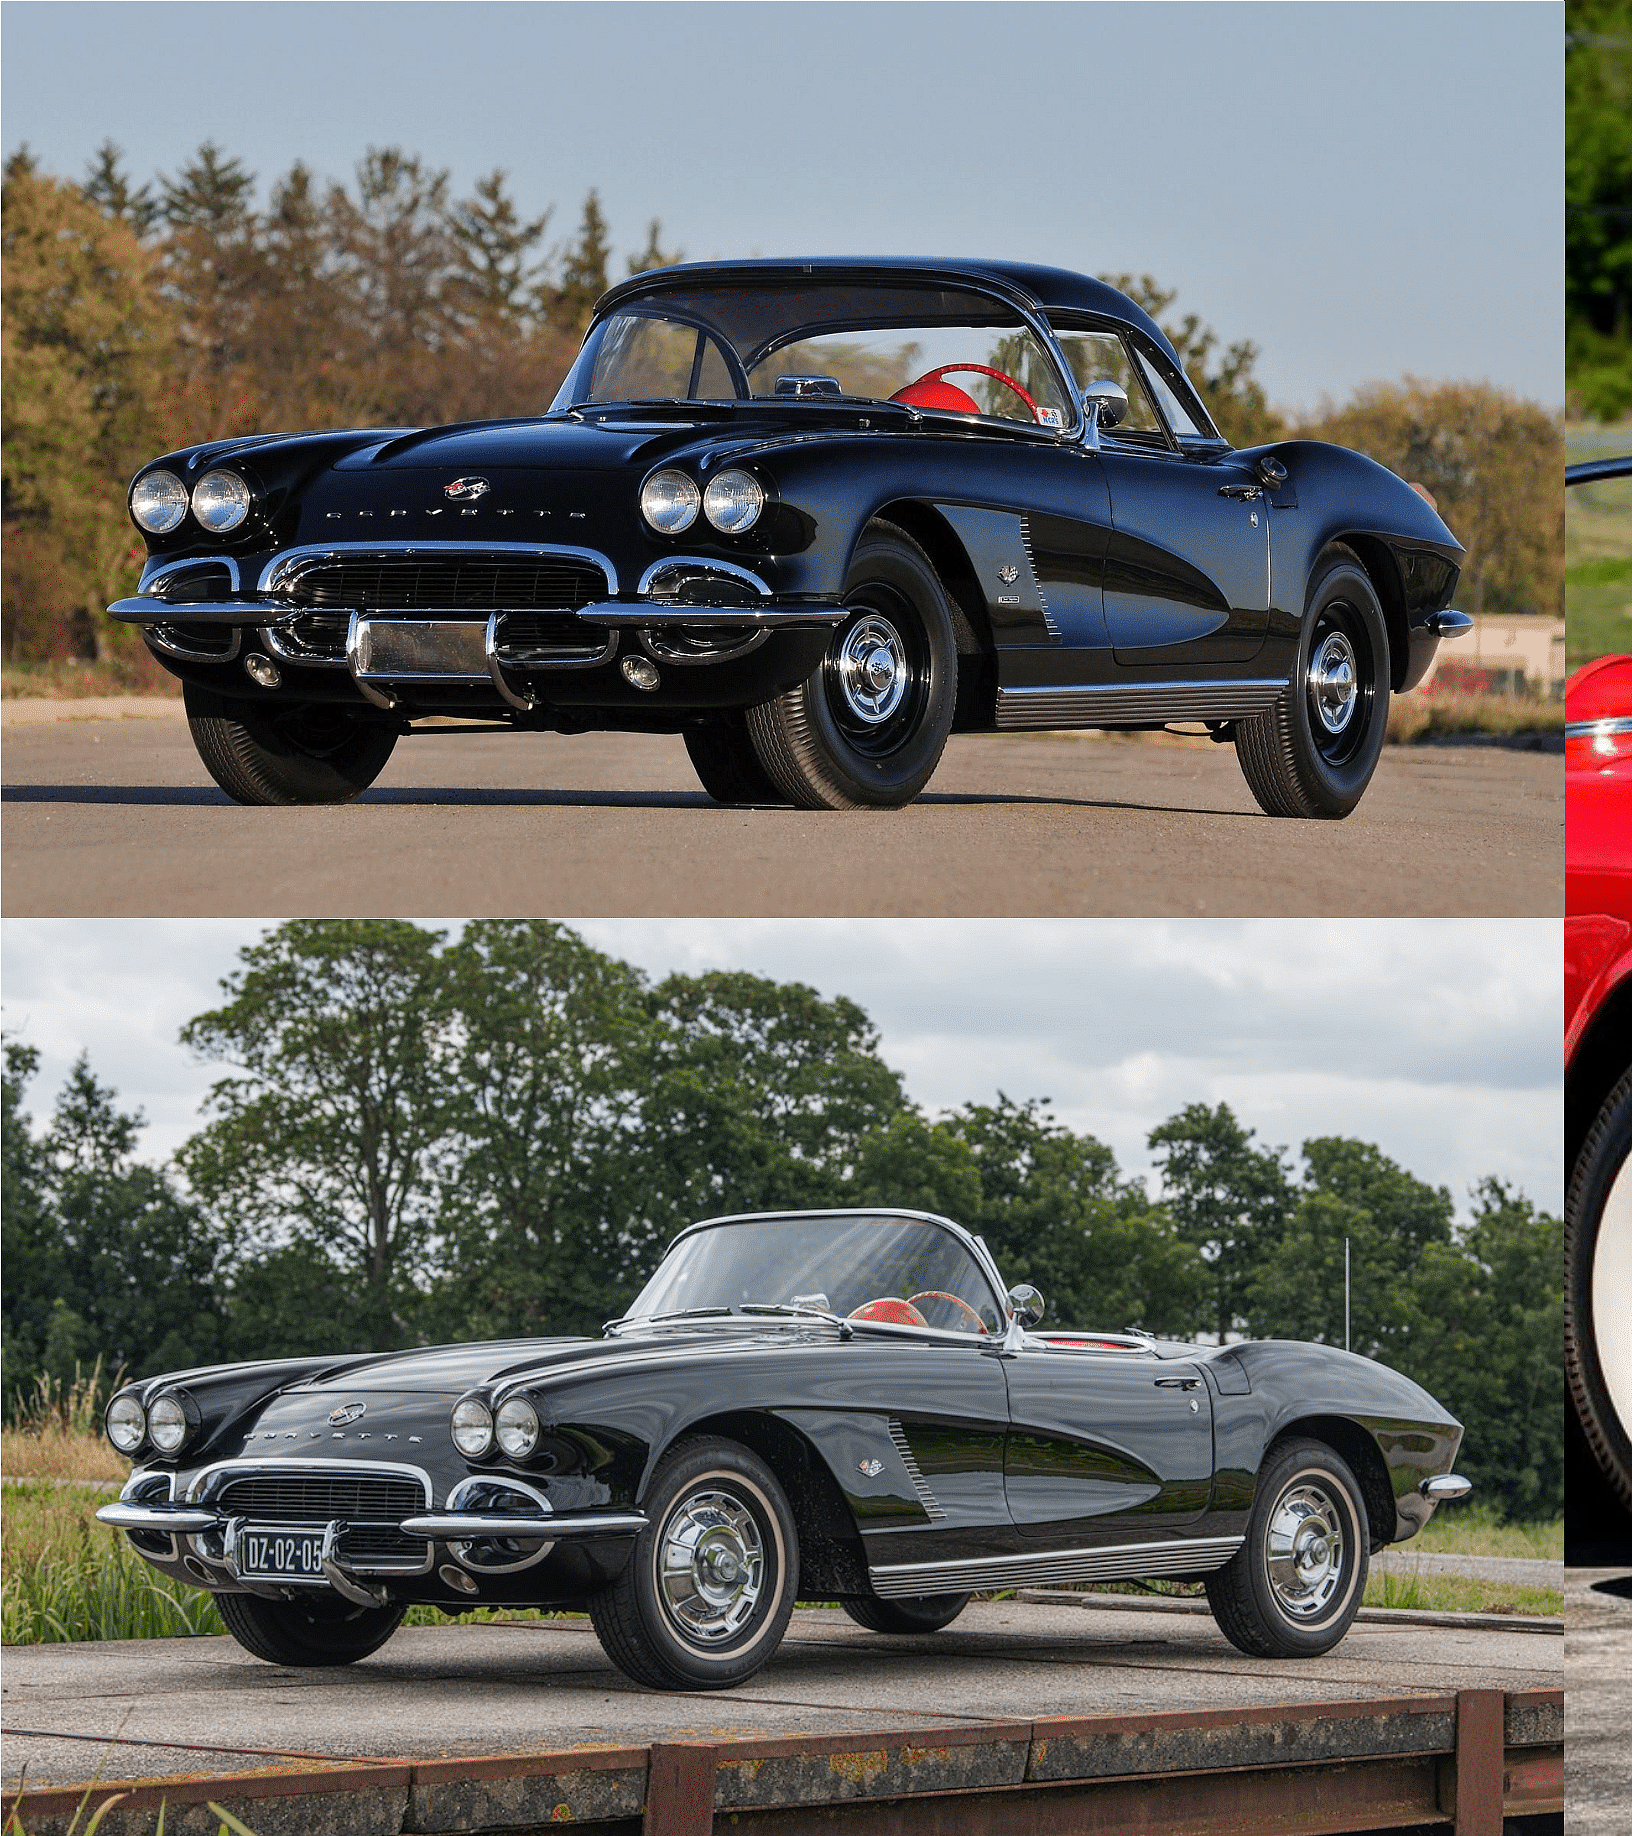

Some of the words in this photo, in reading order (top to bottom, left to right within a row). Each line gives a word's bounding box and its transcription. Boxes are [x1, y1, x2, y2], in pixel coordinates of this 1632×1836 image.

[326, 509, 586, 519] CORVETTE
[243, 1433, 423, 1443] CORVETTE
[248, 1536, 322, 1572] DZ-02-05
